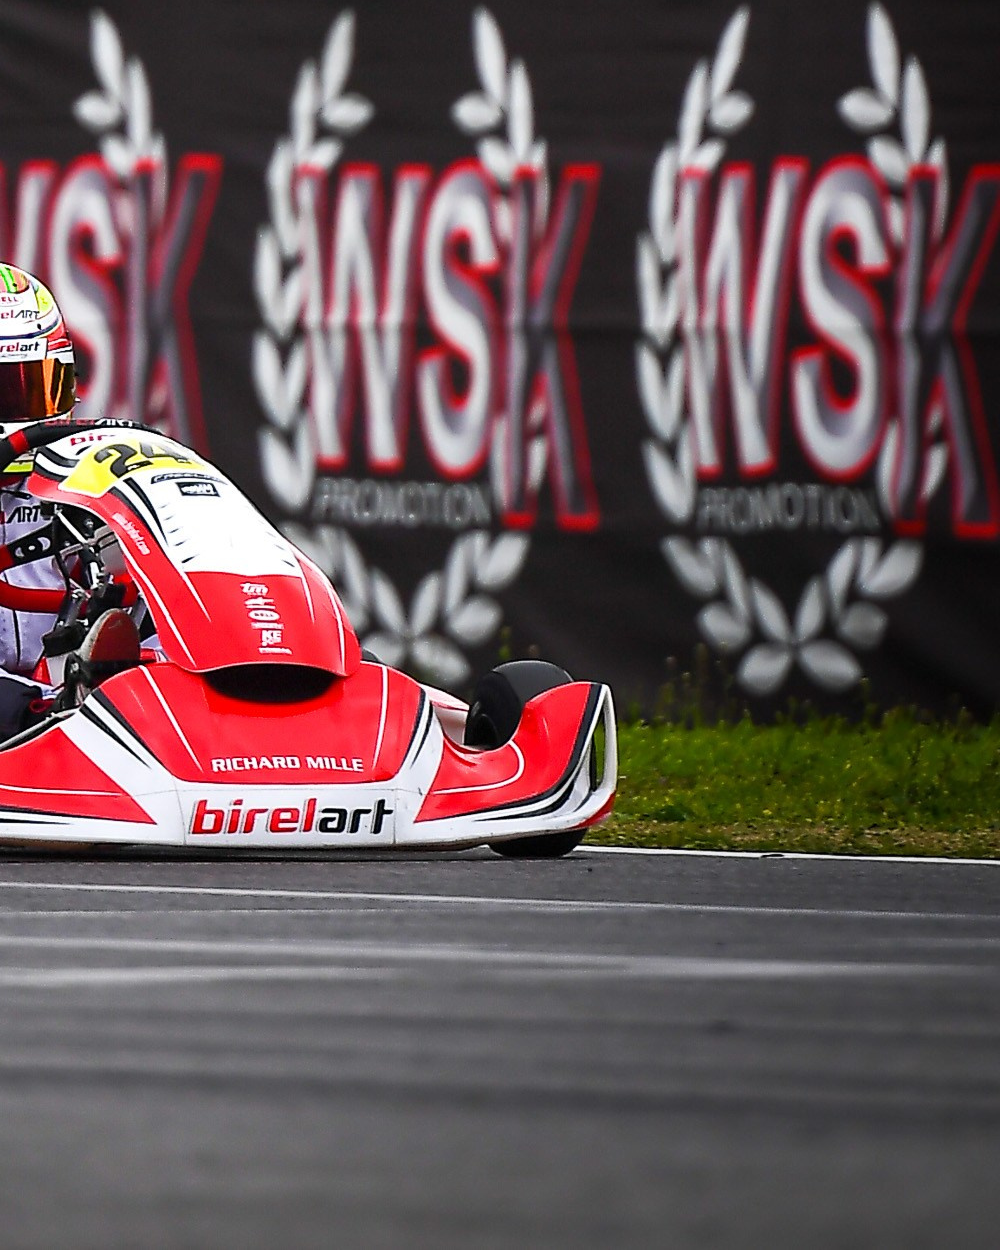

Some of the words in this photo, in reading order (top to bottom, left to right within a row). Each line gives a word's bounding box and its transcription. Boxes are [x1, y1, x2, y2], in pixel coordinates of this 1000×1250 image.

[294, 154, 602, 532] WSK
[676, 152, 1000, 539] WSK
[190, 798, 394, 835] birelart
[212, 756, 300, 772] RICHARD
[307, 756, 364, 772] MILLE
